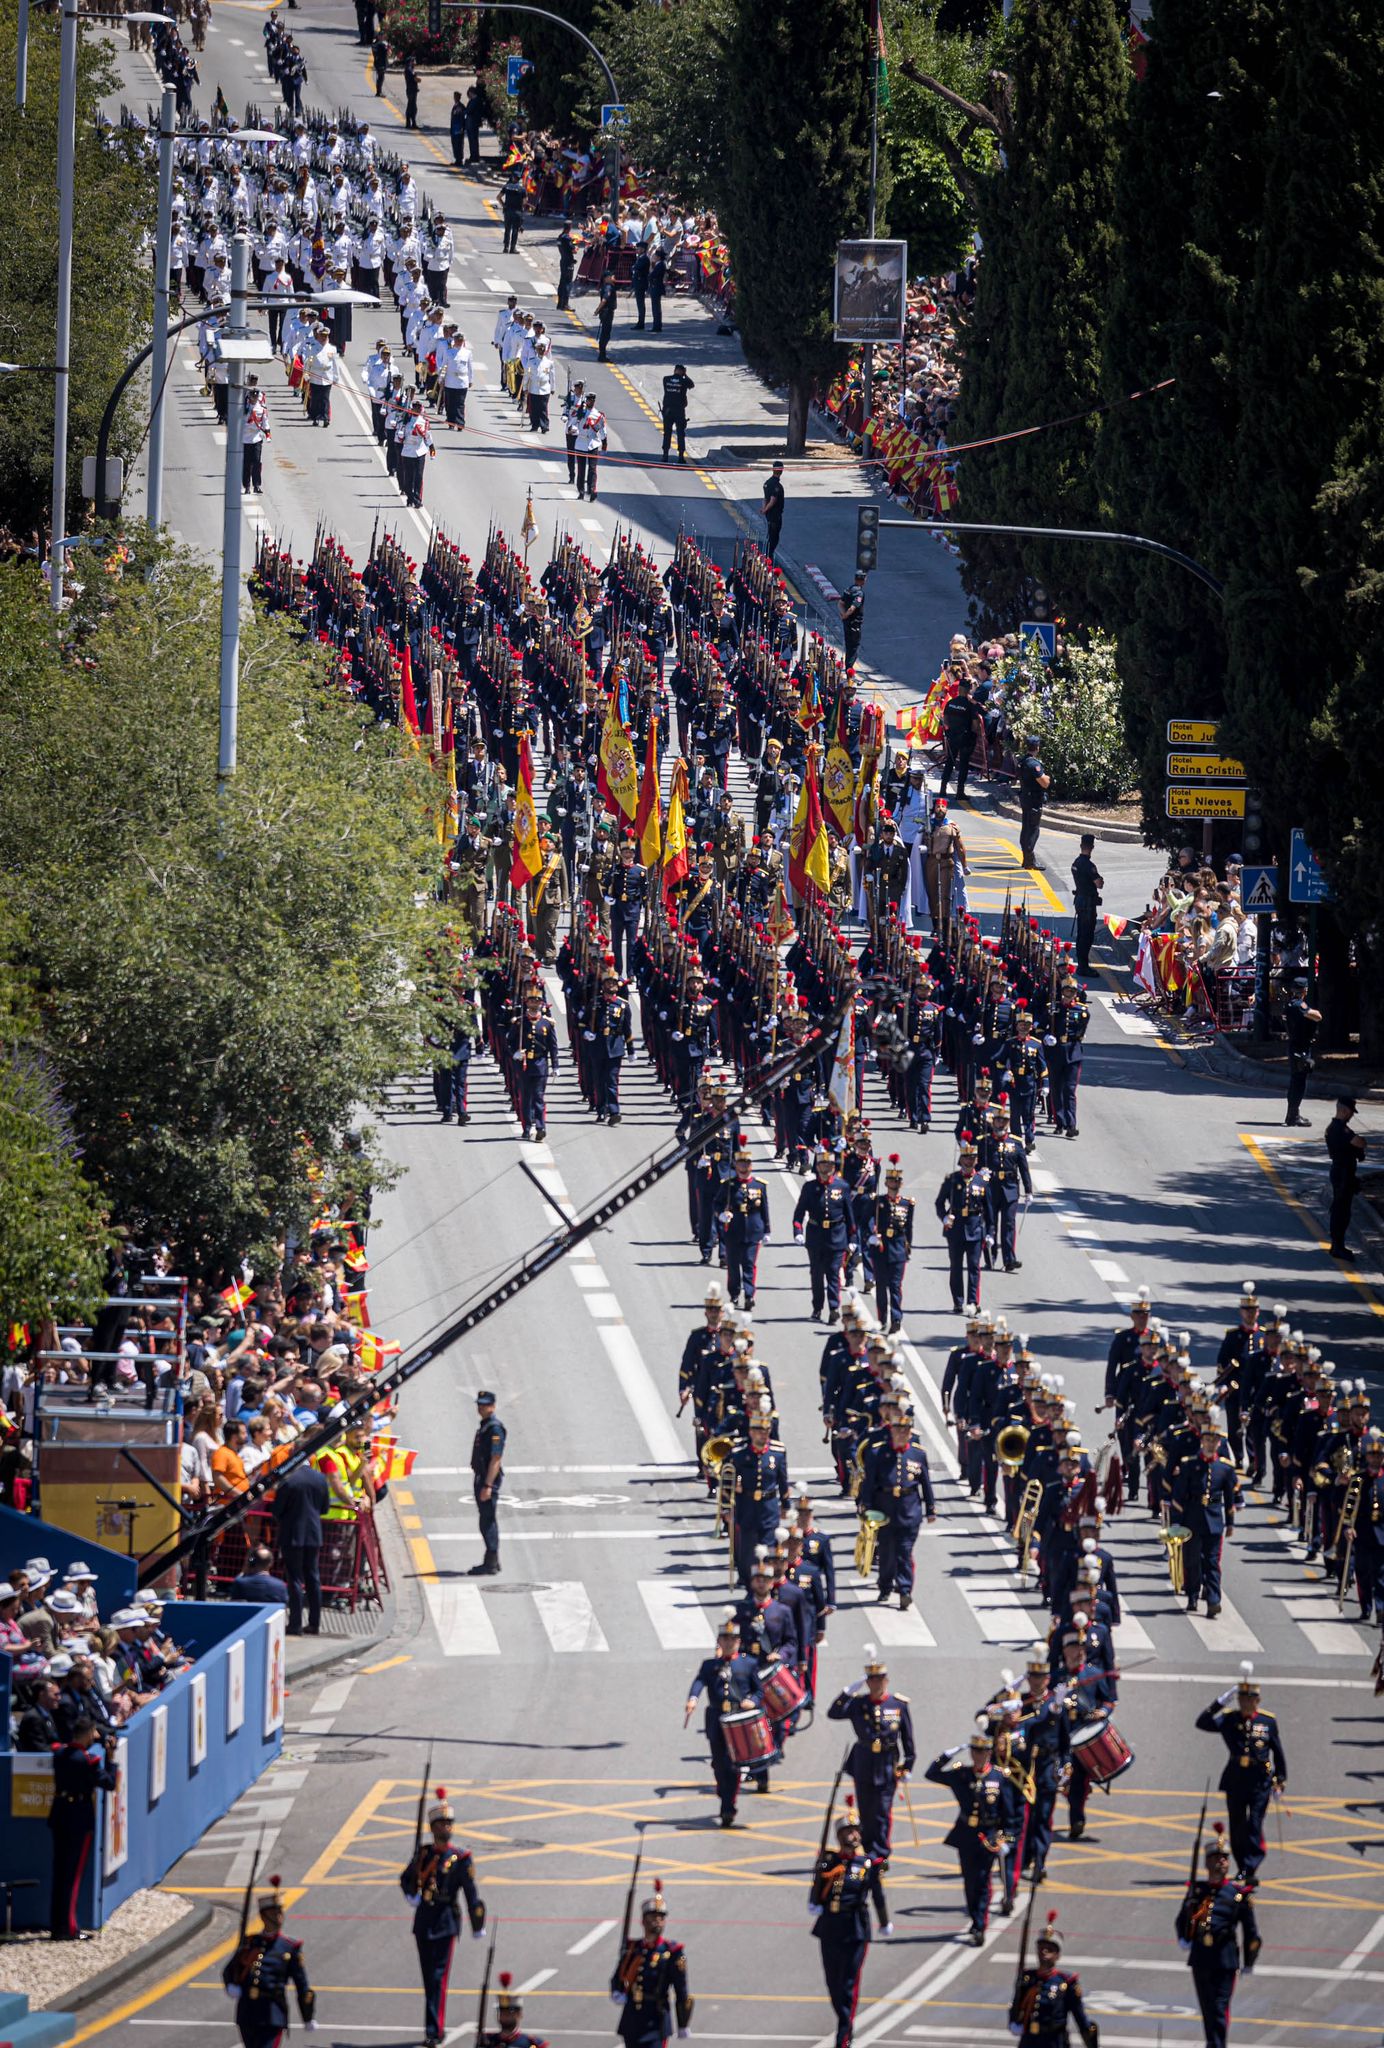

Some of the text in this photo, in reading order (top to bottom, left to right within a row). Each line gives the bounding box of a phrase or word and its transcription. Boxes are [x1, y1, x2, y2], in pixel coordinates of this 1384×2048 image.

[1172, 723, 1193, 731] Hotel
[1172, 731, 1217, 741] Don Ju
[1172, 756, 1193, 764] Hotel
[1172, 765, 1202, 774] Reina
[1171, 788, 1192, 796] Hotel
[1171, 797, 1232, 806] Las Nieves
[1171, 806, 1238, 817] Sacromonte
